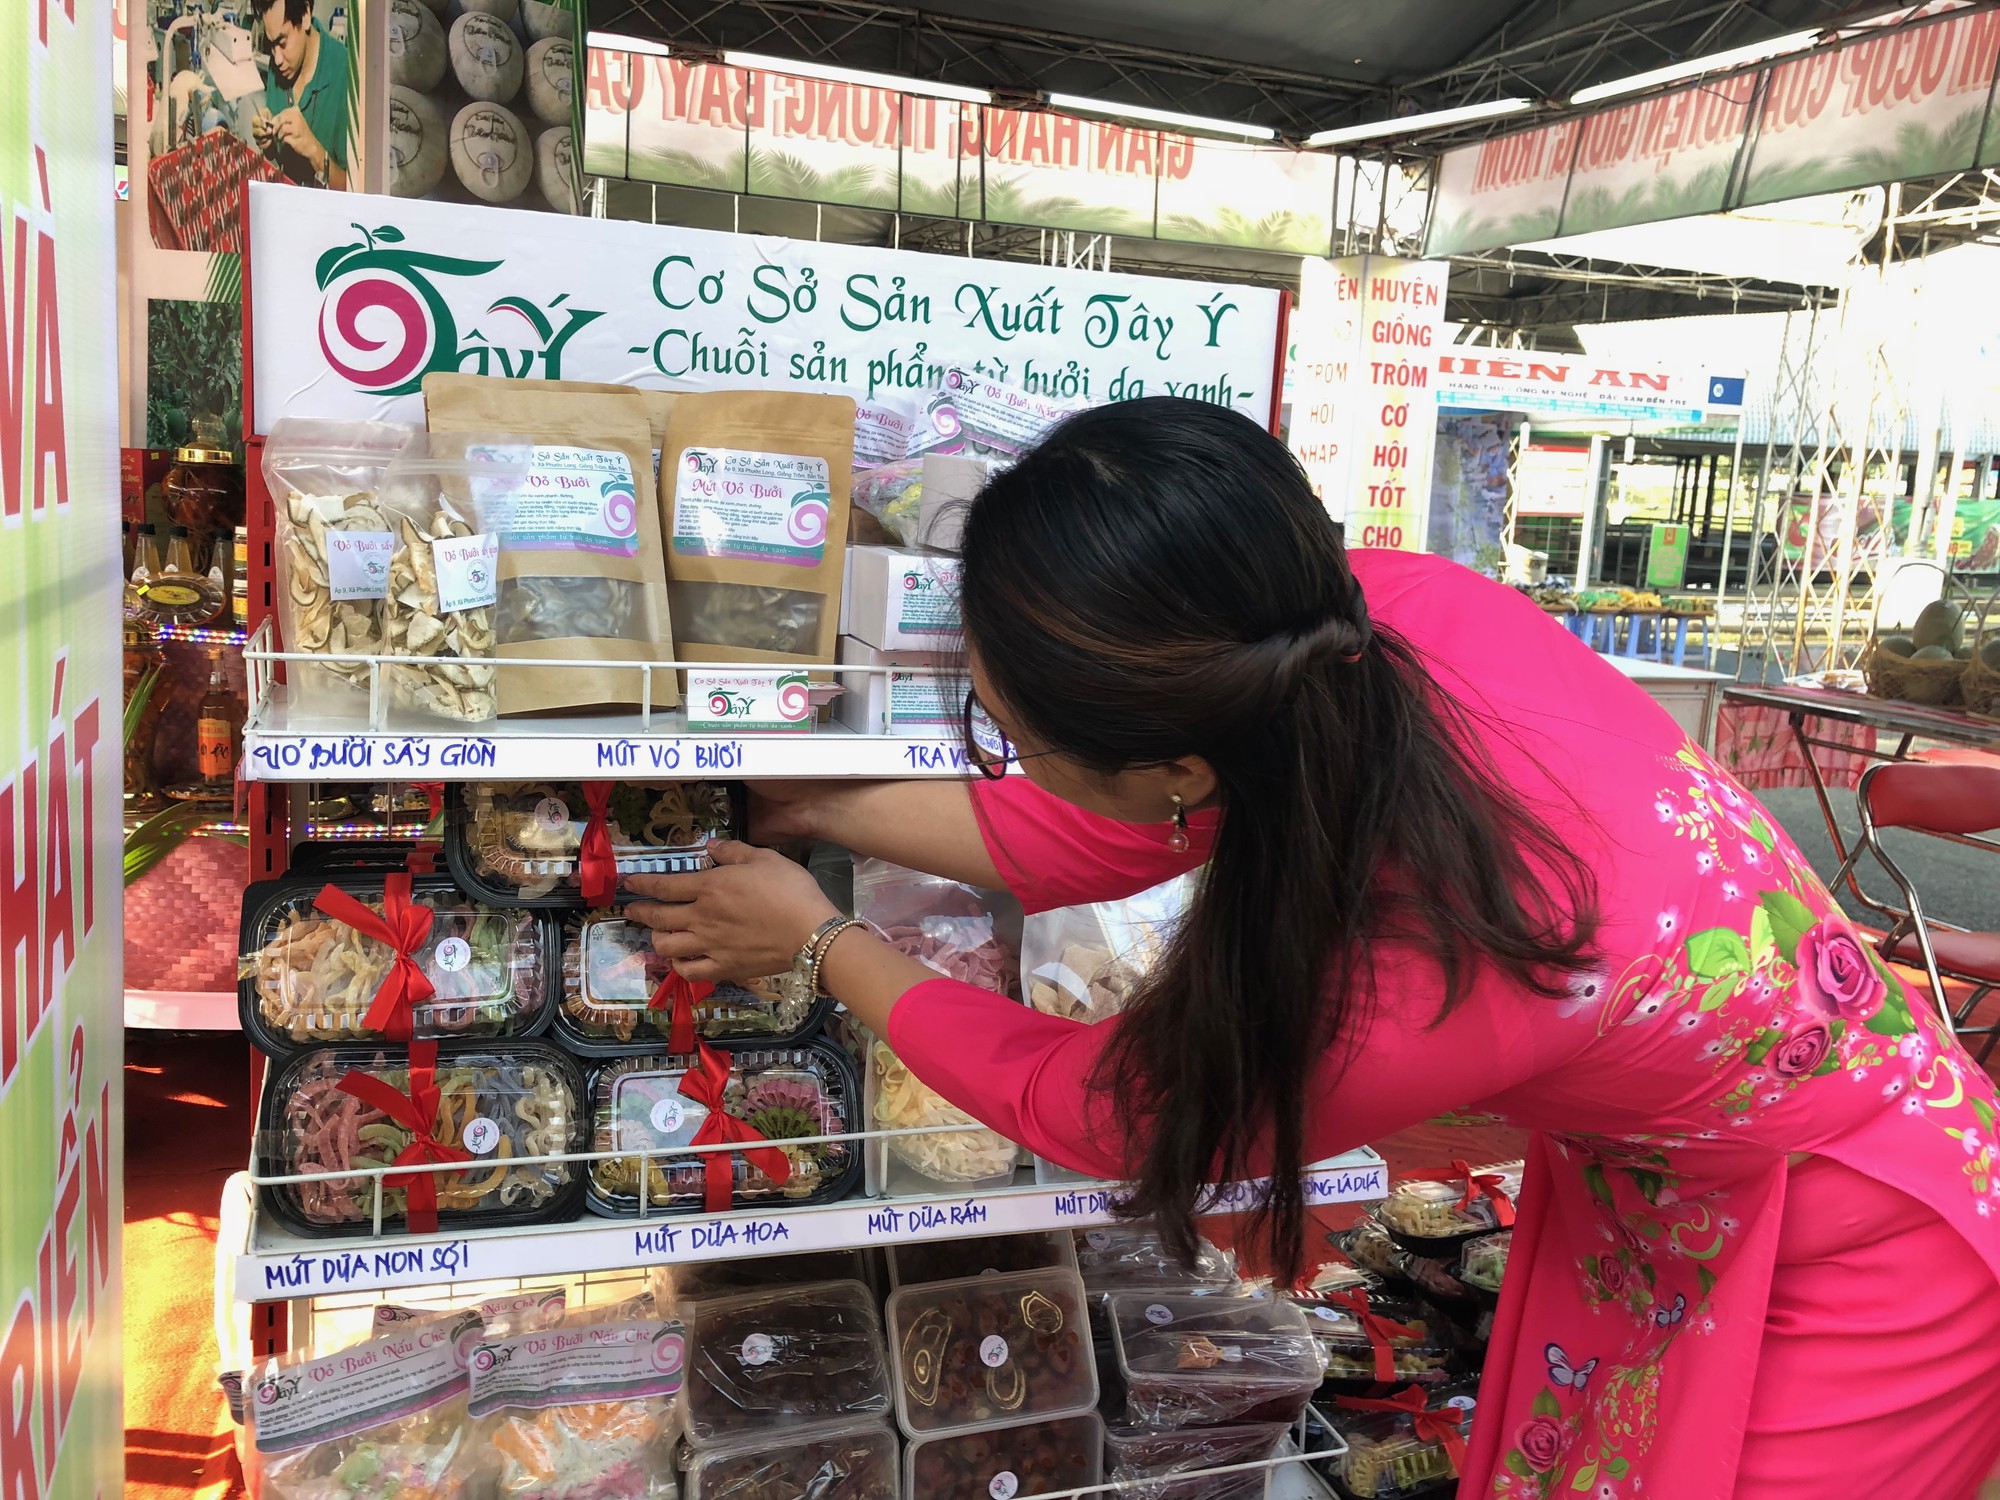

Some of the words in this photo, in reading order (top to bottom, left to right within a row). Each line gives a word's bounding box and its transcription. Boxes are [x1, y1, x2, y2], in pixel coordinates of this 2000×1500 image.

[1371, 277, 1438, 309] HUYỆN
[652, 255, 725, 311] Cơ
[747, 265, 819, 324] Sở
[840, 274, 932, 332] Sản
[954, 282, 1065, 341] Xuất
[1084, 293, 1174, 361] Tây
[1195, 292, 1239, 348] Ý
[1372, 313, 1432, 347] GIỒNG
[789, 340, 849, 384] sản
[1370, 359, 1428, 388] TRÔM
[984, 384, 1001, 399] Vỏ
[1381, 402, 1410, 427] CƠ
[725, 456, 737, 465] Cơ
[739, 457, 751, 467] Sở
[754, 458, 770, 468] Sản
[774, 460, 793, 470] Xuất
[797, 462, 812, 473] Tây
[816, 462, 823, 471] Ý
[1373, 440, 1408, 472] HỘI
[526, 475, 549, 488] Vỏ
[555, 476, 590, 489] Bưởi
[692, 479, 717, 496] Mứt
[722, 481, 744, 495] Vỏ
[750, 483, 782, 499] Bưởi
[1367, 476, 1406, 508] TỐT
[334, 540, 351, 551] Vỏ
[355, 540, 377, 551] Bưởi
[1362, 526, 1401, 548] CHO
[443, 551, 457, 563] Vỏ
[459, 547, 480, 561] Bưởi
[708, 687, 756, 718] TâyÝ
[904, 742, 946, 768] TRÀ
[951, 1199, 986, 1225] RÁM
[742, 1221, 789, 1245] HOA
[375, 1249, 423, 1278] NON
[482, 1300, 507, 1316] Nấu
[512, 1296, 535, 1312] Chè
[524, 1338, 546, 1354] Vỏ
[552, 1331, 583, 1350] Bưởi
[590, 1326, 618, 1346] Nấu
[625, 1328, 650, 1343] Chè
[308, 1363, 334, 1382] Vỏ
[340, 1352, 377, 1373] Bưởi
[382, 1338, 413, 1358] Nấu
[418, 1328, 446, 1349] Chè
